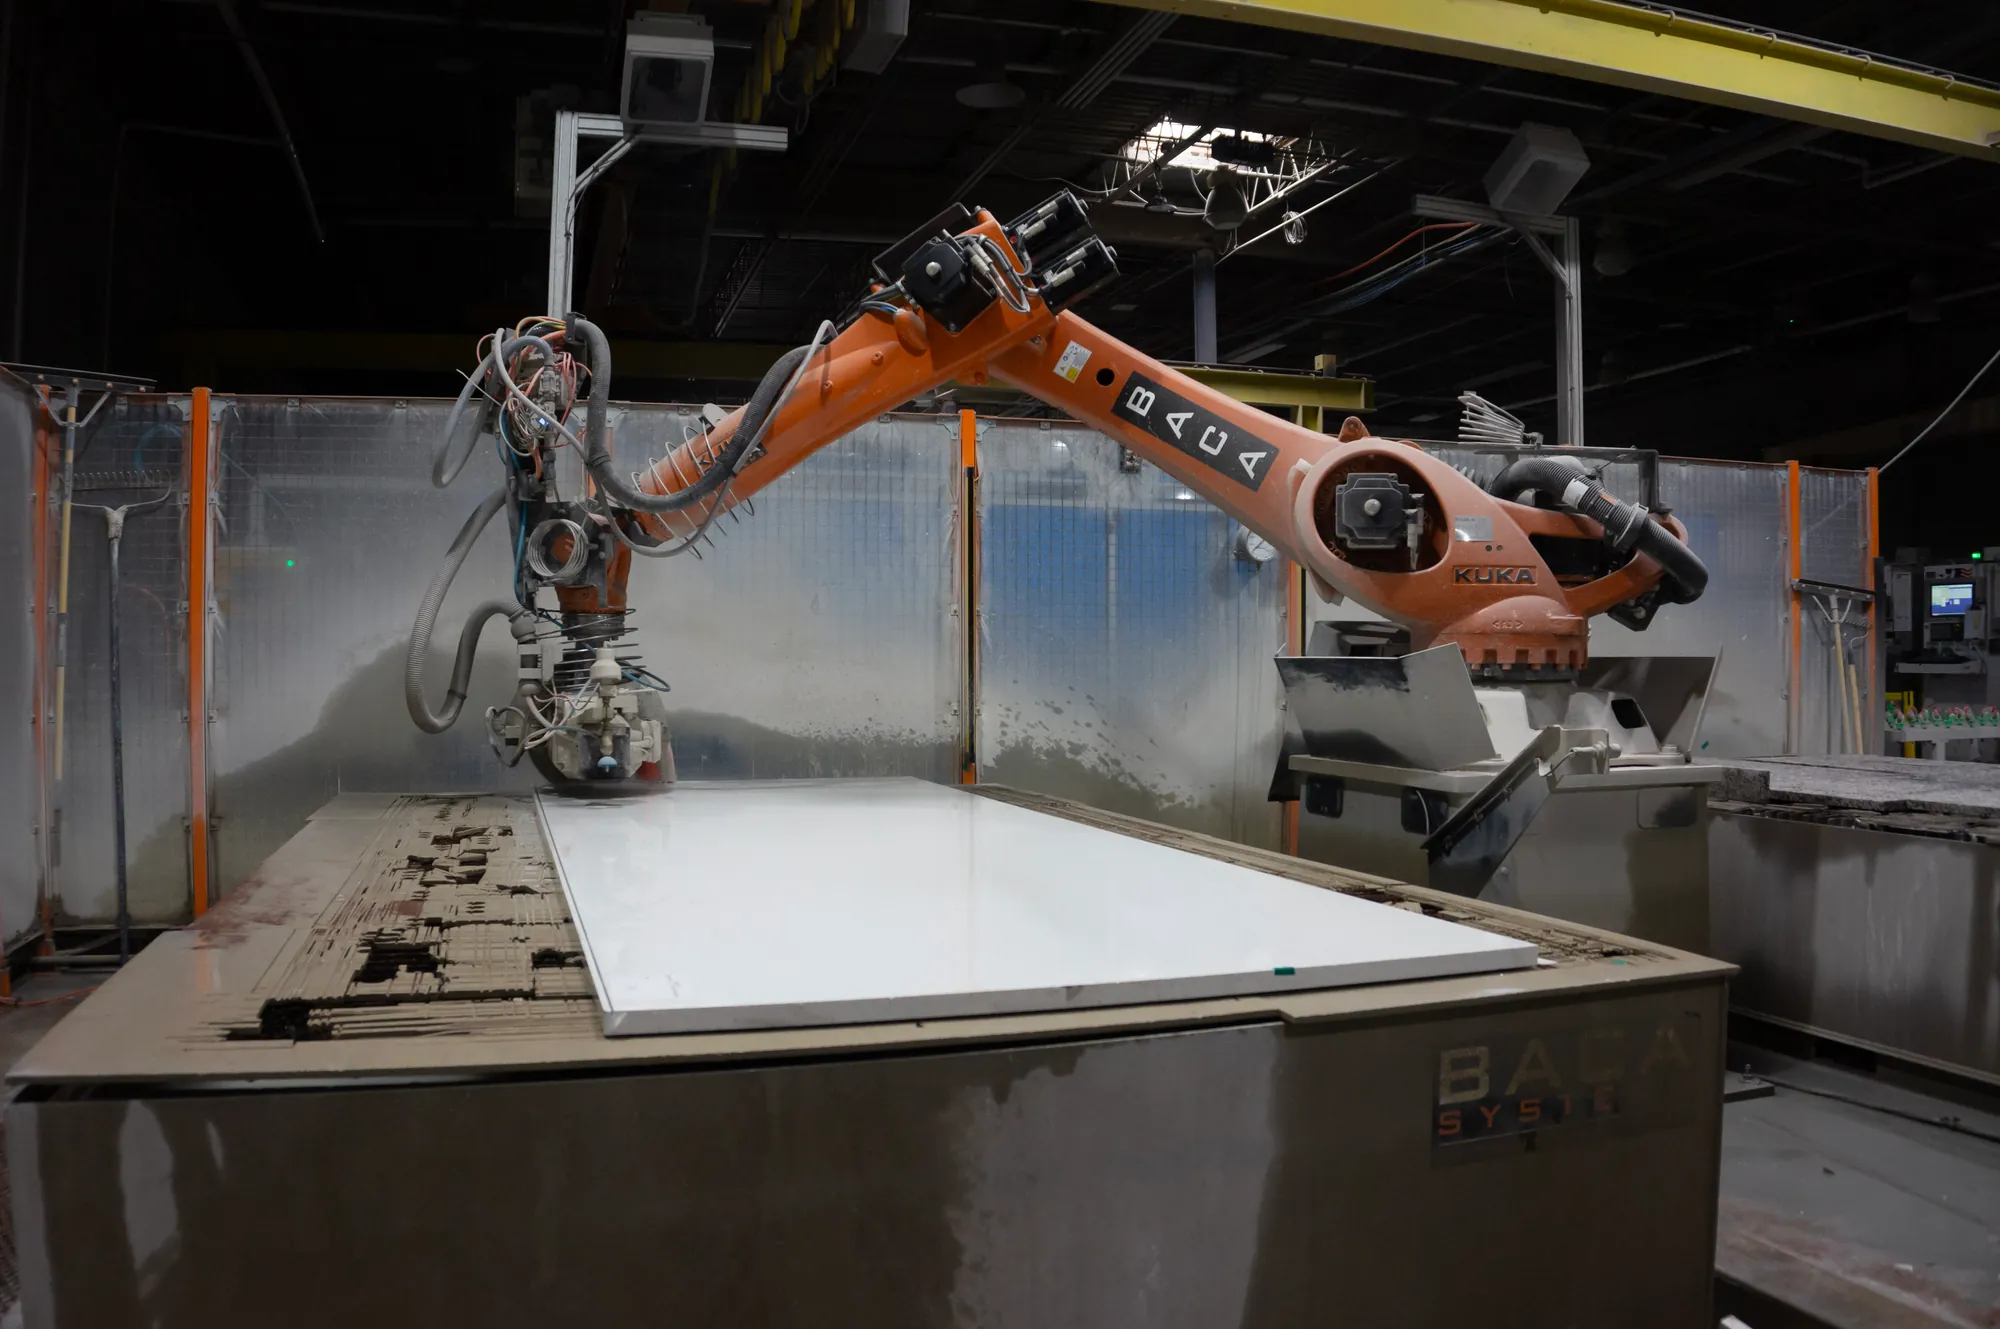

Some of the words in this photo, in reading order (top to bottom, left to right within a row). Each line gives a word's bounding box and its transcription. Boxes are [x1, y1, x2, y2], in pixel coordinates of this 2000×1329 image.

[1126, 386, 1267, 479] BACA
[1455, 568, 1535, 584] KUKA
[1439, 1024, 1694, 1105] BACA
